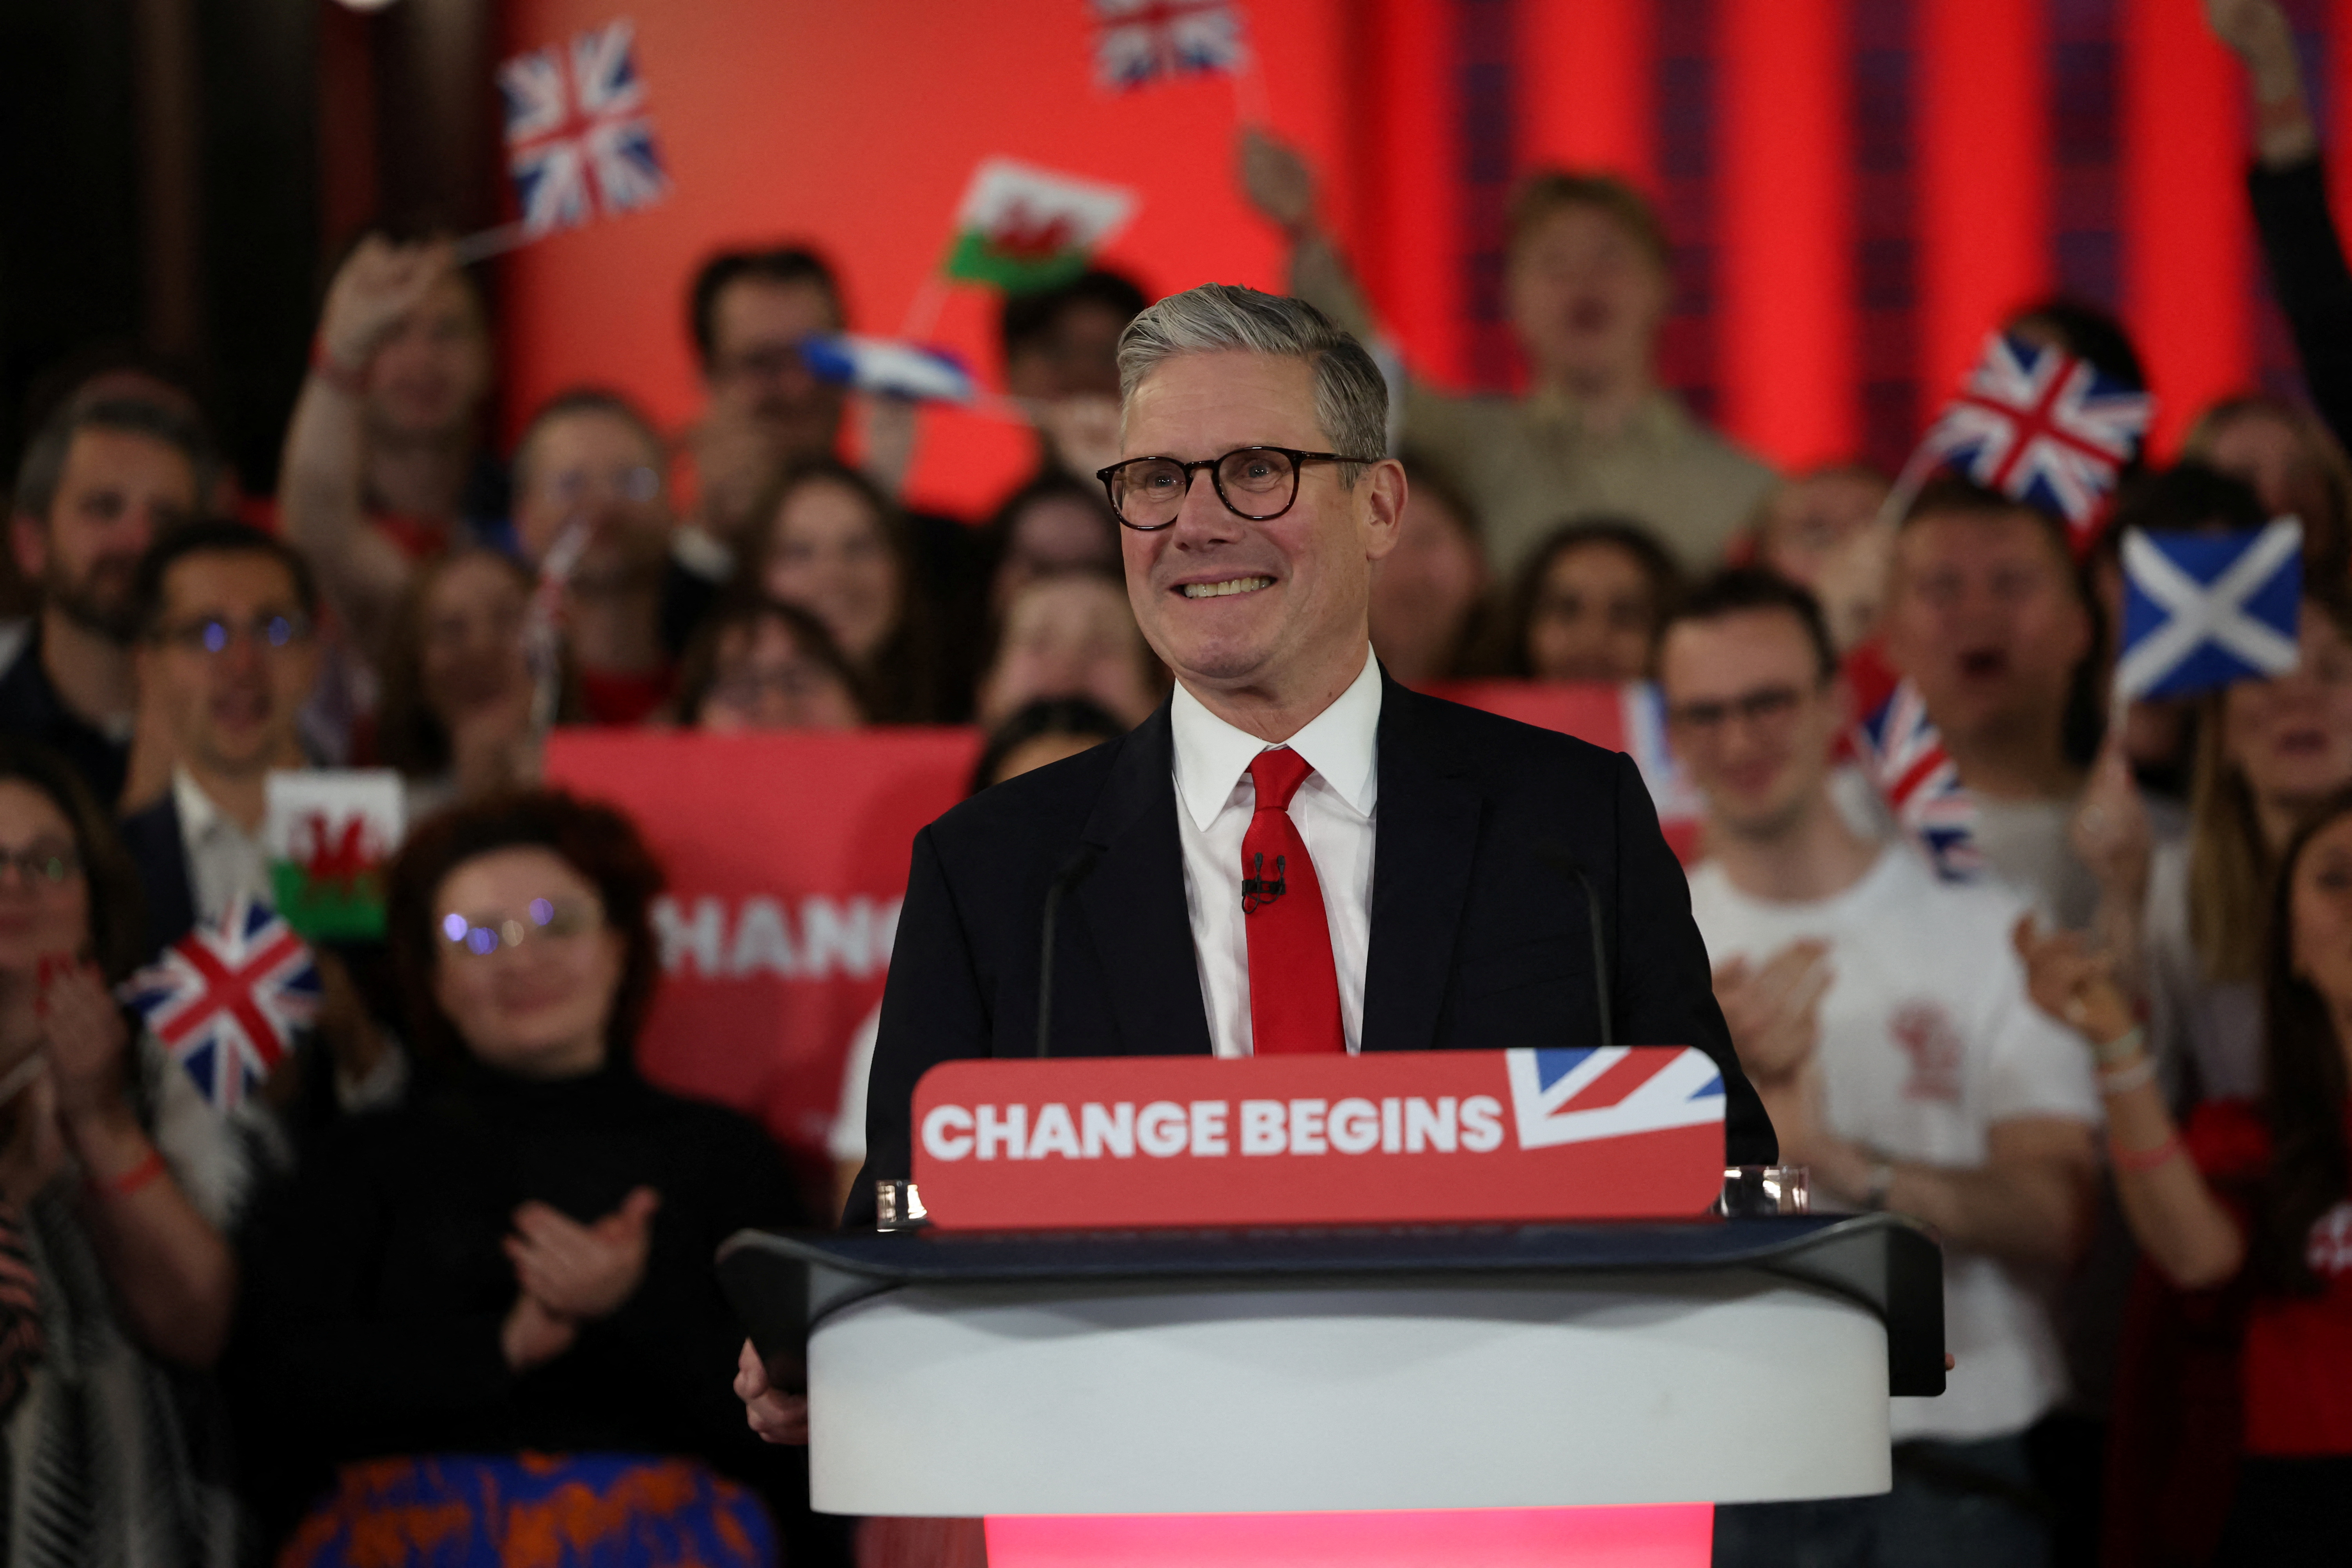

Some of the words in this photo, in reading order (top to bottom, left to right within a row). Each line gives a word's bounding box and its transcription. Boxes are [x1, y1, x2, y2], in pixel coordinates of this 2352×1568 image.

[651, 897, 903, 978] HAN
[922, 1100, 1229, 1161] CHANGE
[1240, 1096, 1503, 1156] BEGINS
